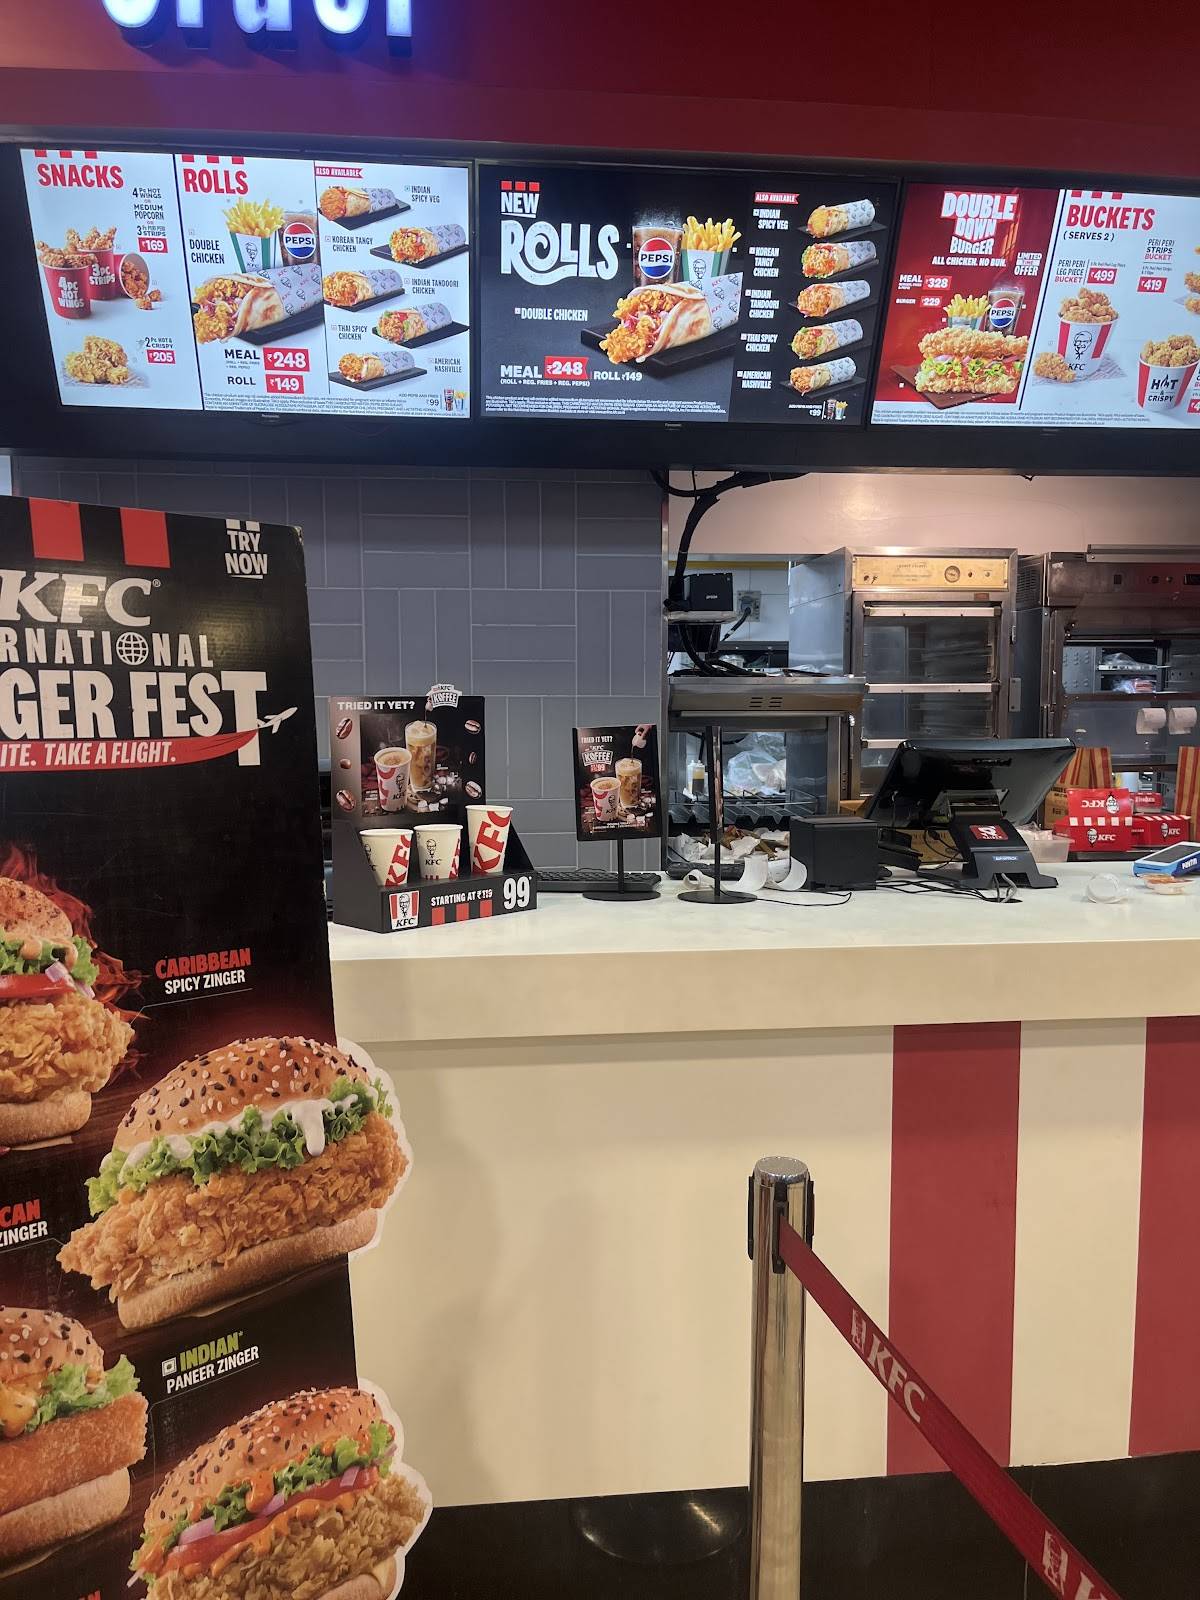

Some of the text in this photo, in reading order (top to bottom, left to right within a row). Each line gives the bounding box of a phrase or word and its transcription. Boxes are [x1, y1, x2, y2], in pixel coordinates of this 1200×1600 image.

[37, 164, 124, 188] SNACKS
[316, 168, 360, 177] ALSO AVAILABLE
[183, 168, 248, 195] ROLLS
[132, 188, 138, 197] 4
[411, 186, 431, 194] INDIAN
[411, 194, 440, 203] SPICY VEG
[501, 192, 540, 214] NEW
[769, 194, 796, 202] AVAILABLE
[942, 192, 1017, 220] DOUBLE
[135, 211, 165, 220] POPCORN
[759, 209, 781, 219] INDIAN
[1066, 204, 1156, 230] BUCKETS
[758, 219, 789, 230] SPICY VEG
[955, 218, 997, 240] DOWN
[137, 226, 142, 235] 3
[190, 239, 220, 250] DOUBLE
[285, 236, 315, 246] PEPSI
[332, 235, 373, 245] KOREAN TANGY
[1148, 238, 1175, 247] PERI PERI
[332, 244, 357, 253] CHICKEN
[950, 236, 995, 255] BURGER
[501, 220, 620, 286] ROLLS
[755, 247, 780, 257] KOREAN
[191, 252, 225, 265] CHICKEN
[640, 253, 673, 264] PEPSI
[754, 257, 775, 267] TANGY
[932, 256, 1006, 267] ALL CHICKEN. NO BUN.
[1058, 259, 1071, 268] PERI
[1073, 260, 1085, 268] PERI
[753, 267, 779, 278] CHICKEN
[1014, 266, 1039, 276] OFFER
[1056, 268, 1085, 278] LEG PIECE
[89, 273, 116, 286] STRIPS
[412, 278, 459, 288] INDIAN TANDOORI
[899, 274, 923, 283] MEAL
[60, 290, 79, 299] HOT
[412, 286, 436, 295] CHICKEN
[751, 289, 772, 299] INDIAN
[58, 297, 85, 308] WINGS
[750, 300, 780, 309] TANDOORI
[521, 308, 588, 321] DOUBLE CHICKEN
[749, 309, 775, 319] CHICKEN
[991, 308, 1015, 317] PEPSI
[338, 325, 367, 333] THAI SPICY
[338, 332, 362, 341] CHICKEN
[746, 333, 778, 343] THAI SPICY
[144, 337, 151, 348] 2
[745, 343, 771, 352] CHICKEN
[225, 349, 260, 360] MEAL
[266, 352, 307, 367] ₹248
[434, 358, 460, 366] AMERICAN
[434, 365, 462, 373] NASHVILLE
[500, 365, 542, 378] MEAL
[546, 361, 584, 376] ₹248
[593, 371, 620, 381] ROLL
[1068, 363, 1086, 371] KFC
[742, 370, 772, 380] AMERICAN
[228, 377, 300, 391] ROLL ₹149
[741, 380, 772, 389] NASHVILLE
[227, 530, 261, 552] TRY
[224, 552, 268, 575] NOW
[433, 691, 457, 704] KOFFEE
[337, 701, 415, 711] TRIED IT YET?
[0, 667, 268, 766] GER FEST
[45, 743, 95, 766] TAKE
[95, 743, 107, 765] A
[110, 741, 176, 764] FLIGHT.
[584, 751, 611, 763] KOFFEE
[503, 876, 531, 910] 99
[431, 893, 466, 907] STARTING
[466, 893, 477, 902] AT
[396, 917, 416, 927] KFC
[155, 948, 251, 979] CARIBBEAN
[164, 969, 246, 995] SPICY ZINGER
[0, 1199, 41, 1228] CAN
[166, 1345, 260, 1394] PANEER ZINGER
[867, 1333, 926, 1423] KFC
